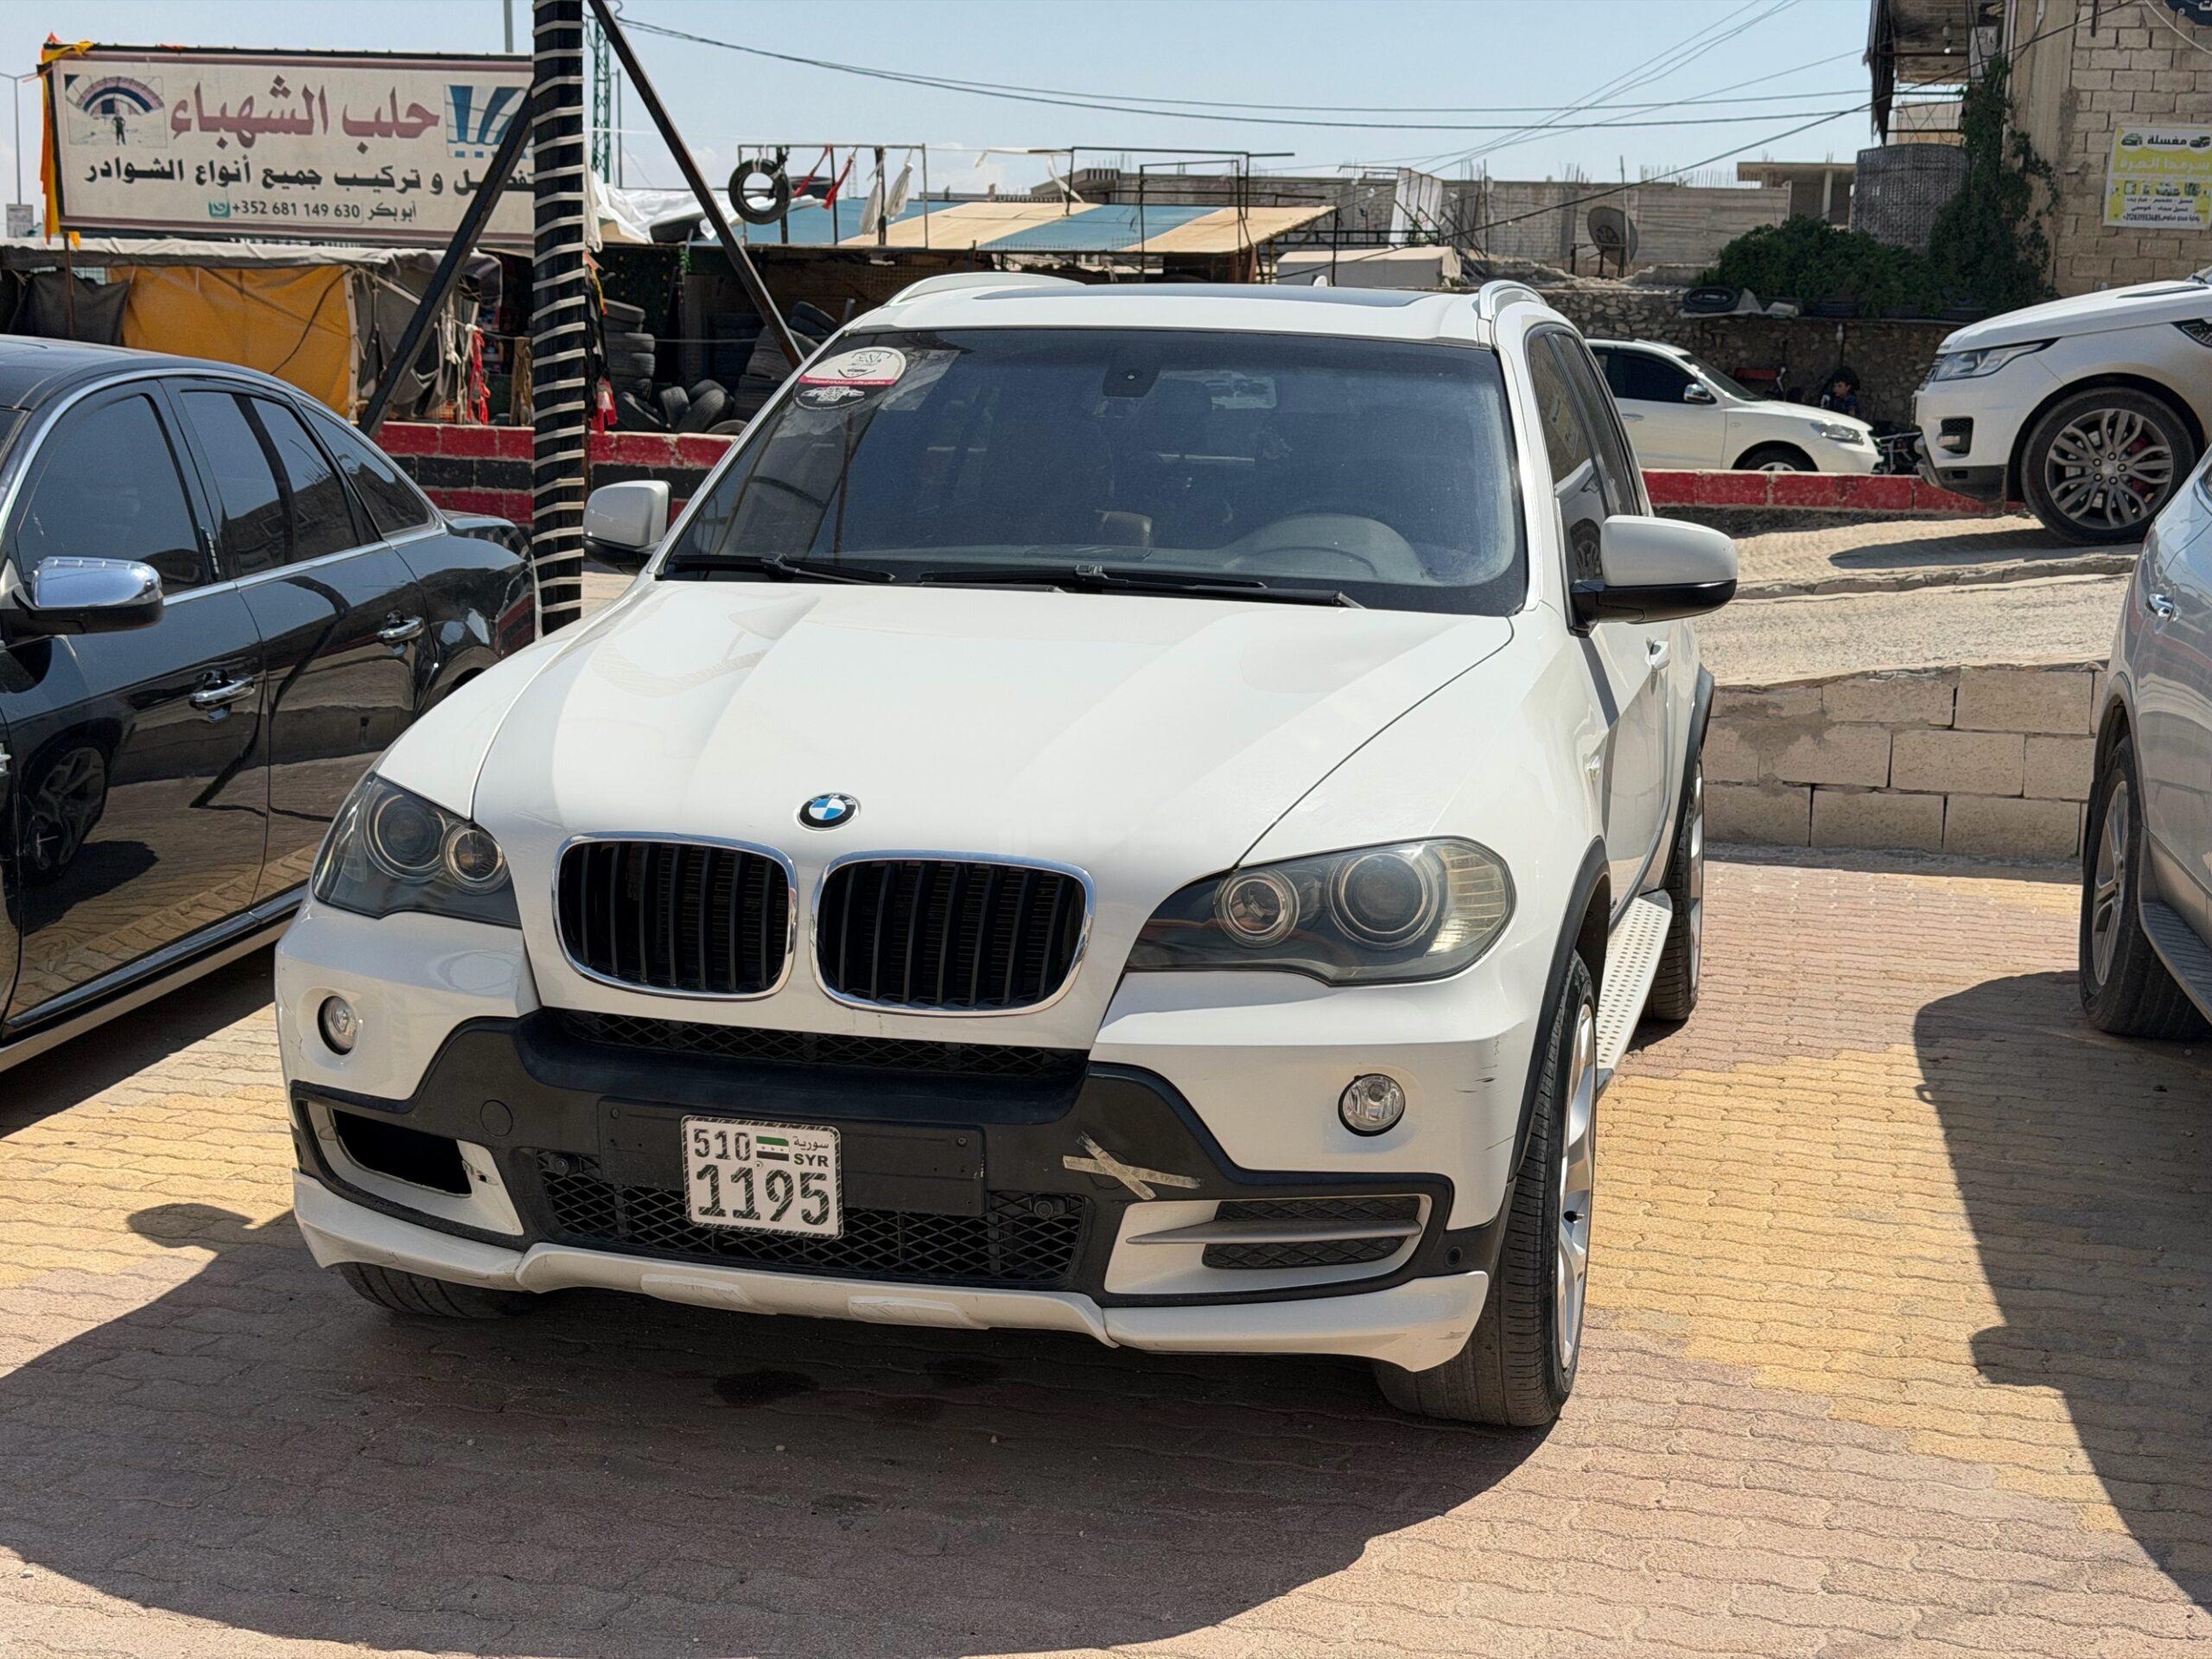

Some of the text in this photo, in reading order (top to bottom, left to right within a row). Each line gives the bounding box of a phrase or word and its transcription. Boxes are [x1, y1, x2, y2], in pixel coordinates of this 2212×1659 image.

[170, 74, 441, 155] حلب الشهباء
[85, 156, 184, 184] الشوادر
[195, 154, 251, 188] أنواع
[262, 168, 322, 189] جميع
[334, 165, 422, 194] تركيب
[429, 173, 443, 195] و
[232, 200, 268, 215] +352
[272, 201, 297, 216] 681
[304, 203, 329, 216] 149
[334, 204, 360, 218] 630
[694, 1128, 751, 1161] 510
[793, 1135, 830, 1151] سورية
[793, 1154, 830, 1167] SYR
[696, 1164, 830, 1225] 1195
